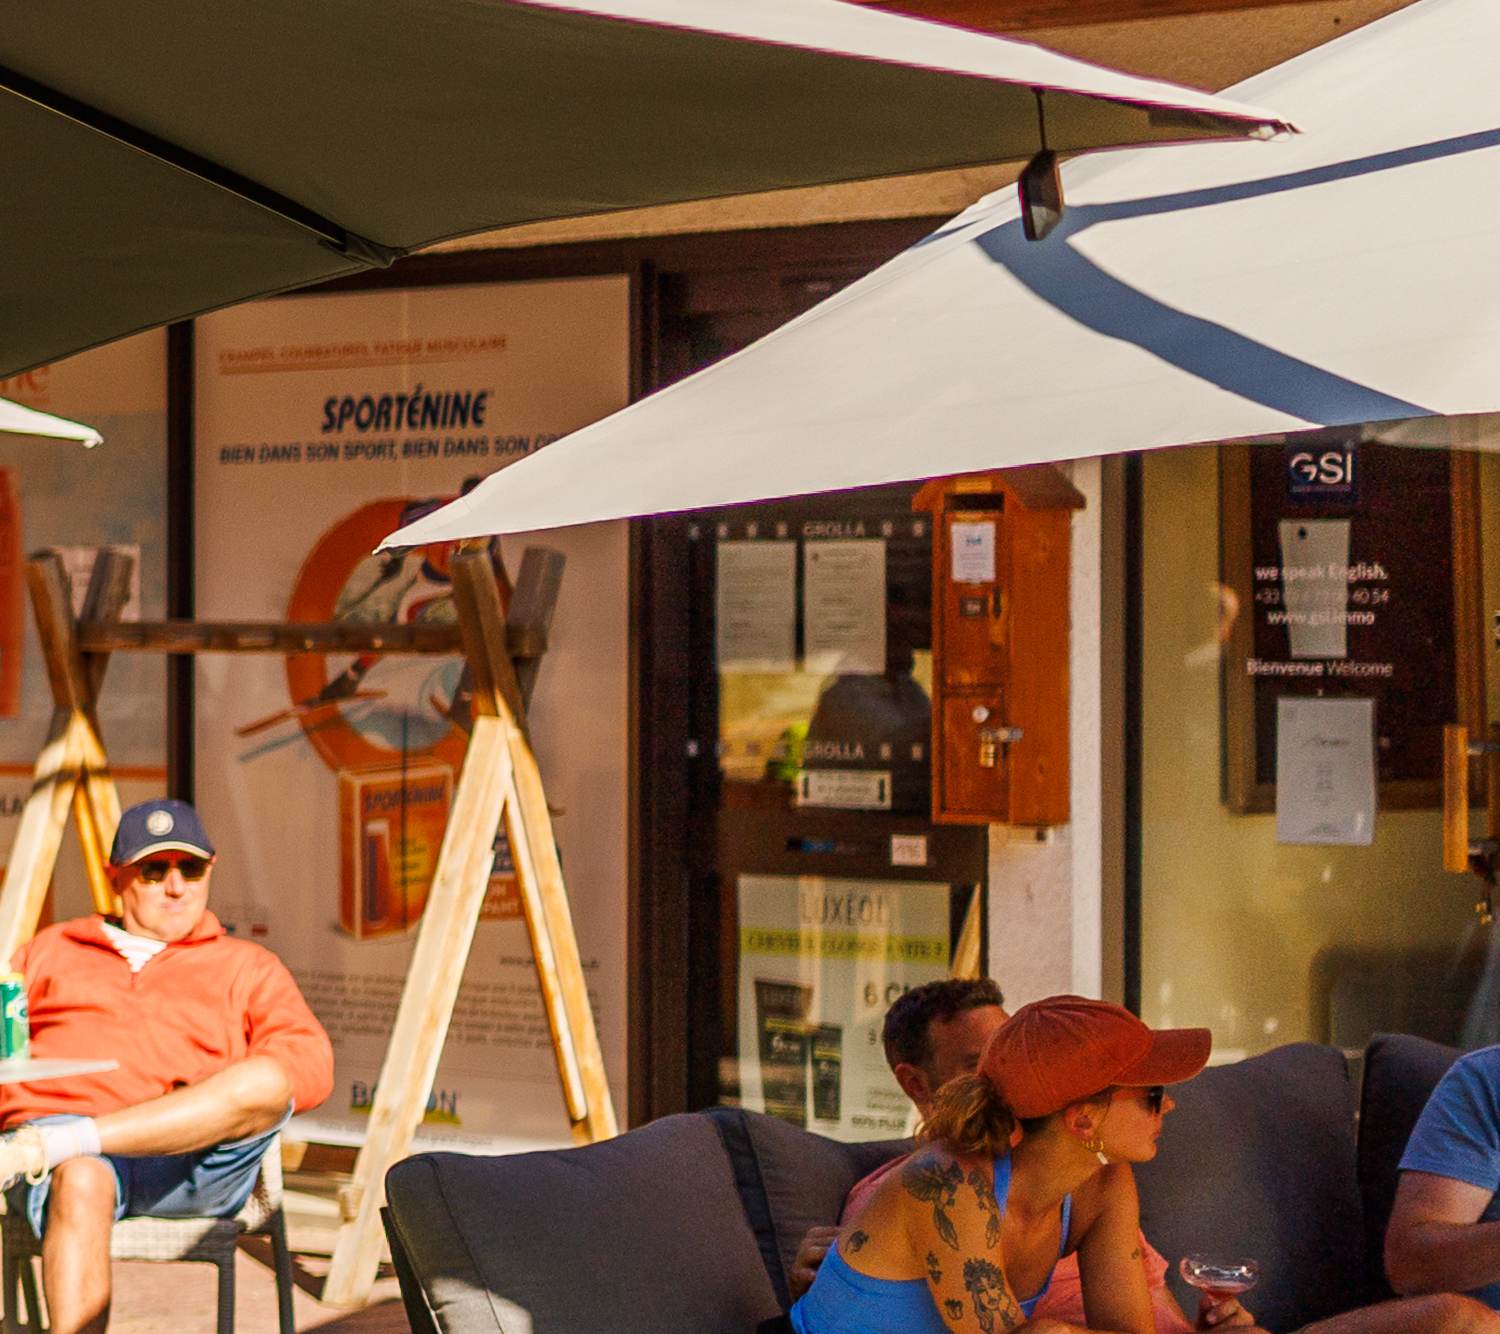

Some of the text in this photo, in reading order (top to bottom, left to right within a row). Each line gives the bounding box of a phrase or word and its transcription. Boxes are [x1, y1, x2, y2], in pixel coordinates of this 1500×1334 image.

[321, 383, 488, 434] SPORTÉNINE
[219, 444, 256, 465] BIEN
[259, 443, 302, 463] DANS
[306, 442, 340, 462] SON
[402, 438, 440, 459] BIEN
[444, 436, 489, 458] DANS
[494, 434, 531, 456] SON
[1289, 451, 1353, 485] GSI
